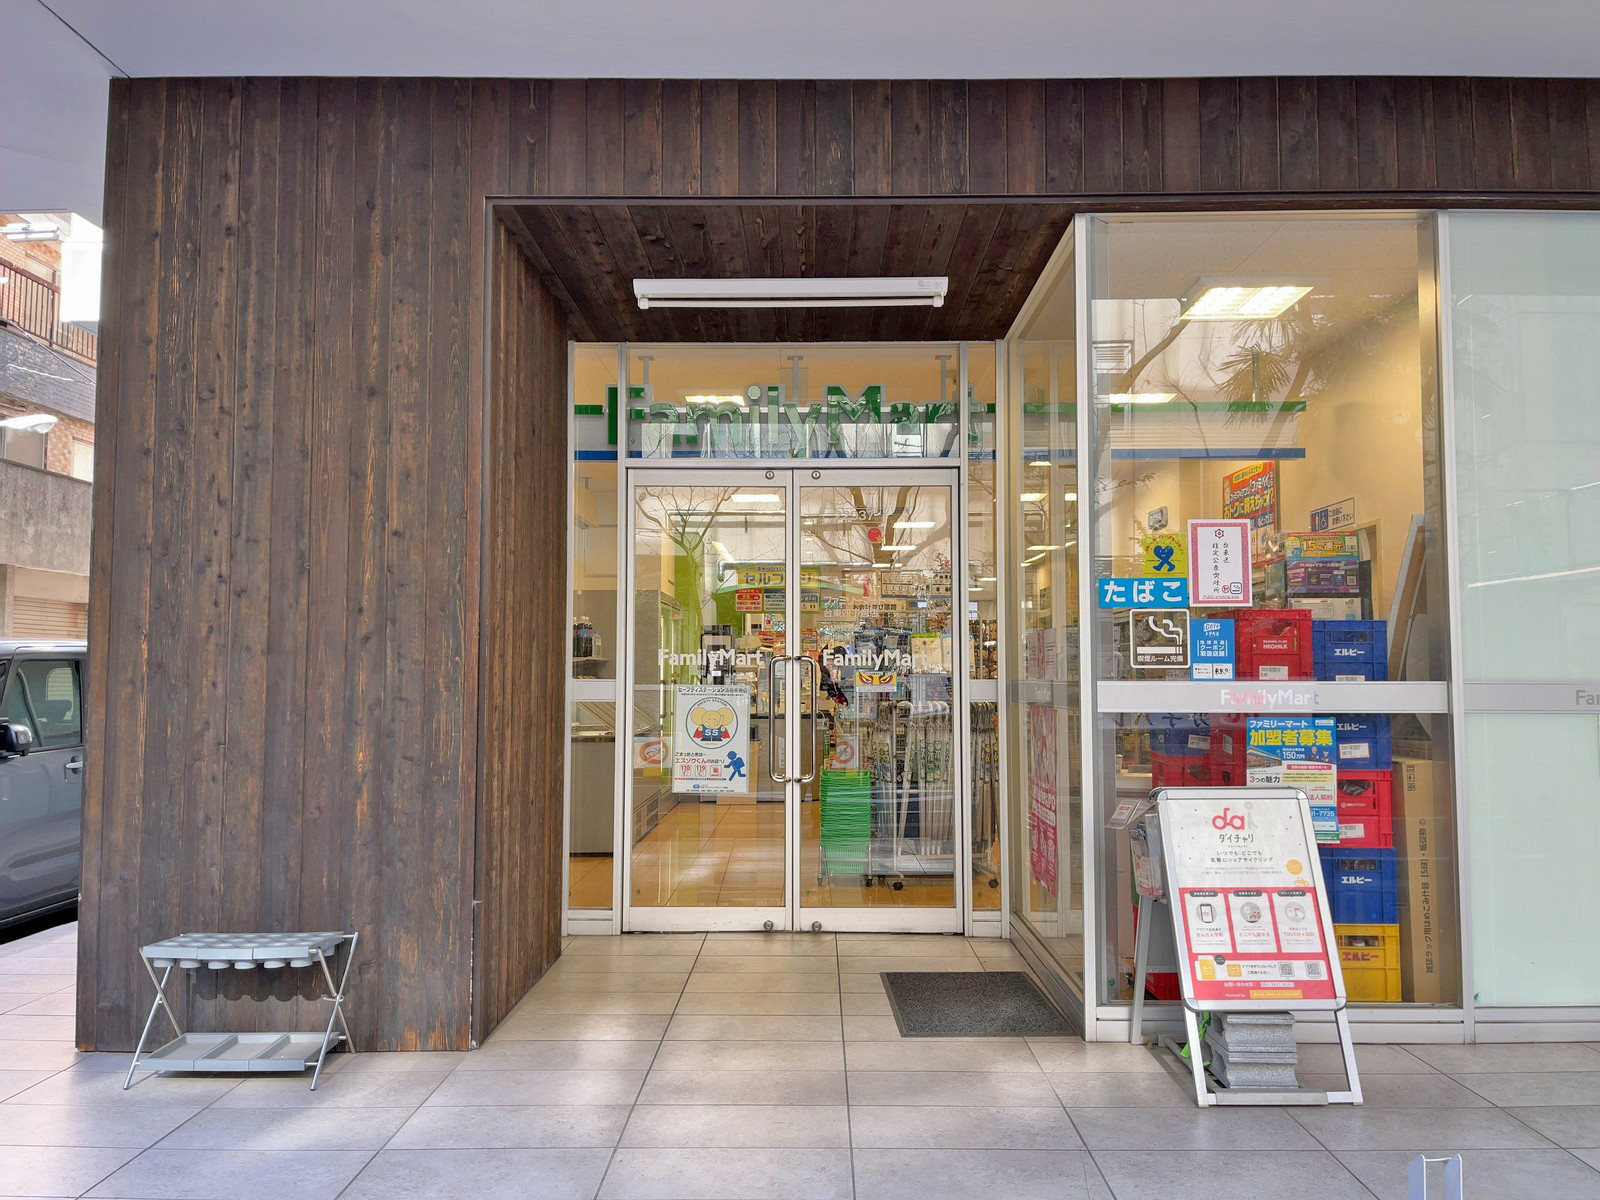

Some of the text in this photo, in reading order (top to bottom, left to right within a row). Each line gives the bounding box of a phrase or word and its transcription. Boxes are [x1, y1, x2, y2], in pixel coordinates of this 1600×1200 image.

[607, 384, 986, 459] FamilyMart
[743, 572, 812, 586] セルフジ
[1104, 580, 1182, 603] たばこ
[658, 649, 764, 671] FamilyMart
[822, 649, 928, 670] FamilyMart
[1220, 690, 1319, 708] FamilyMart
[1250, 720, 1308, 728] ファミリーマート
[1250, 730, 1333, 746] 加盟者募集
[1282, 751, 1305, 759] 150万円
[1219, 833, 1254, 843] ダイチャリ
[1341, 876, 1373, 884] エルビー
[1342, 952, 1379, 961] エルビー
